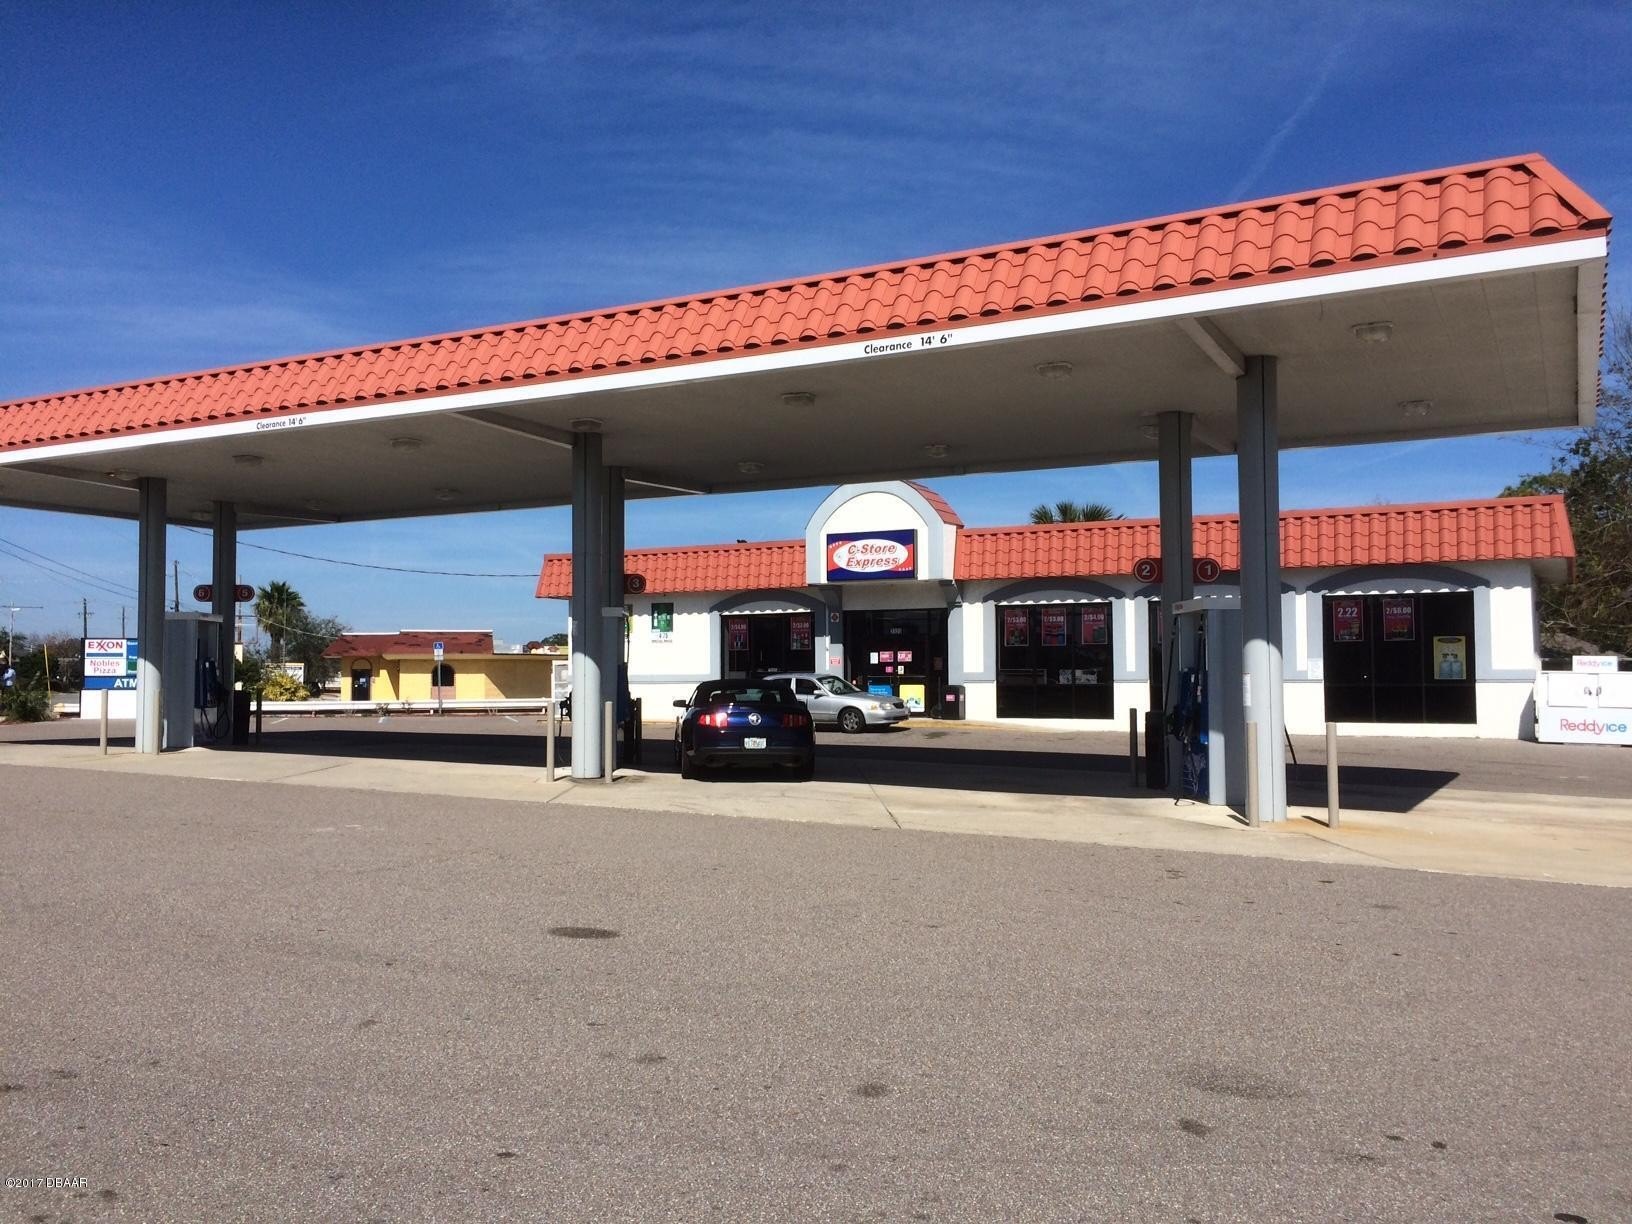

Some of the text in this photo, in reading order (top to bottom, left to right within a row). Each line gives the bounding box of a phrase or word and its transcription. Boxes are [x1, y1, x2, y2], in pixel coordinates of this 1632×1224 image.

[864, 333, 953, 355] Clearance 14' 6"
[256, 420, 286, 430] Clearance
[288, 417, 298, 426] 14'
[847, 542, 897, 556] C-Store
[846, 556, 900, 570] Express
[1141, 564, 1151, 577] 2
[1204, 564, 1212, 576] 1
[632, 579, 640, 588] 3
[1337, 607, 1358, 618] 2.22
[87, 640, 123, 651] EXXON
[89, 659, 120, 667] Nobles
[93, 666, 117, 674] Pizza
[113, 678, 137, 688] ATM
